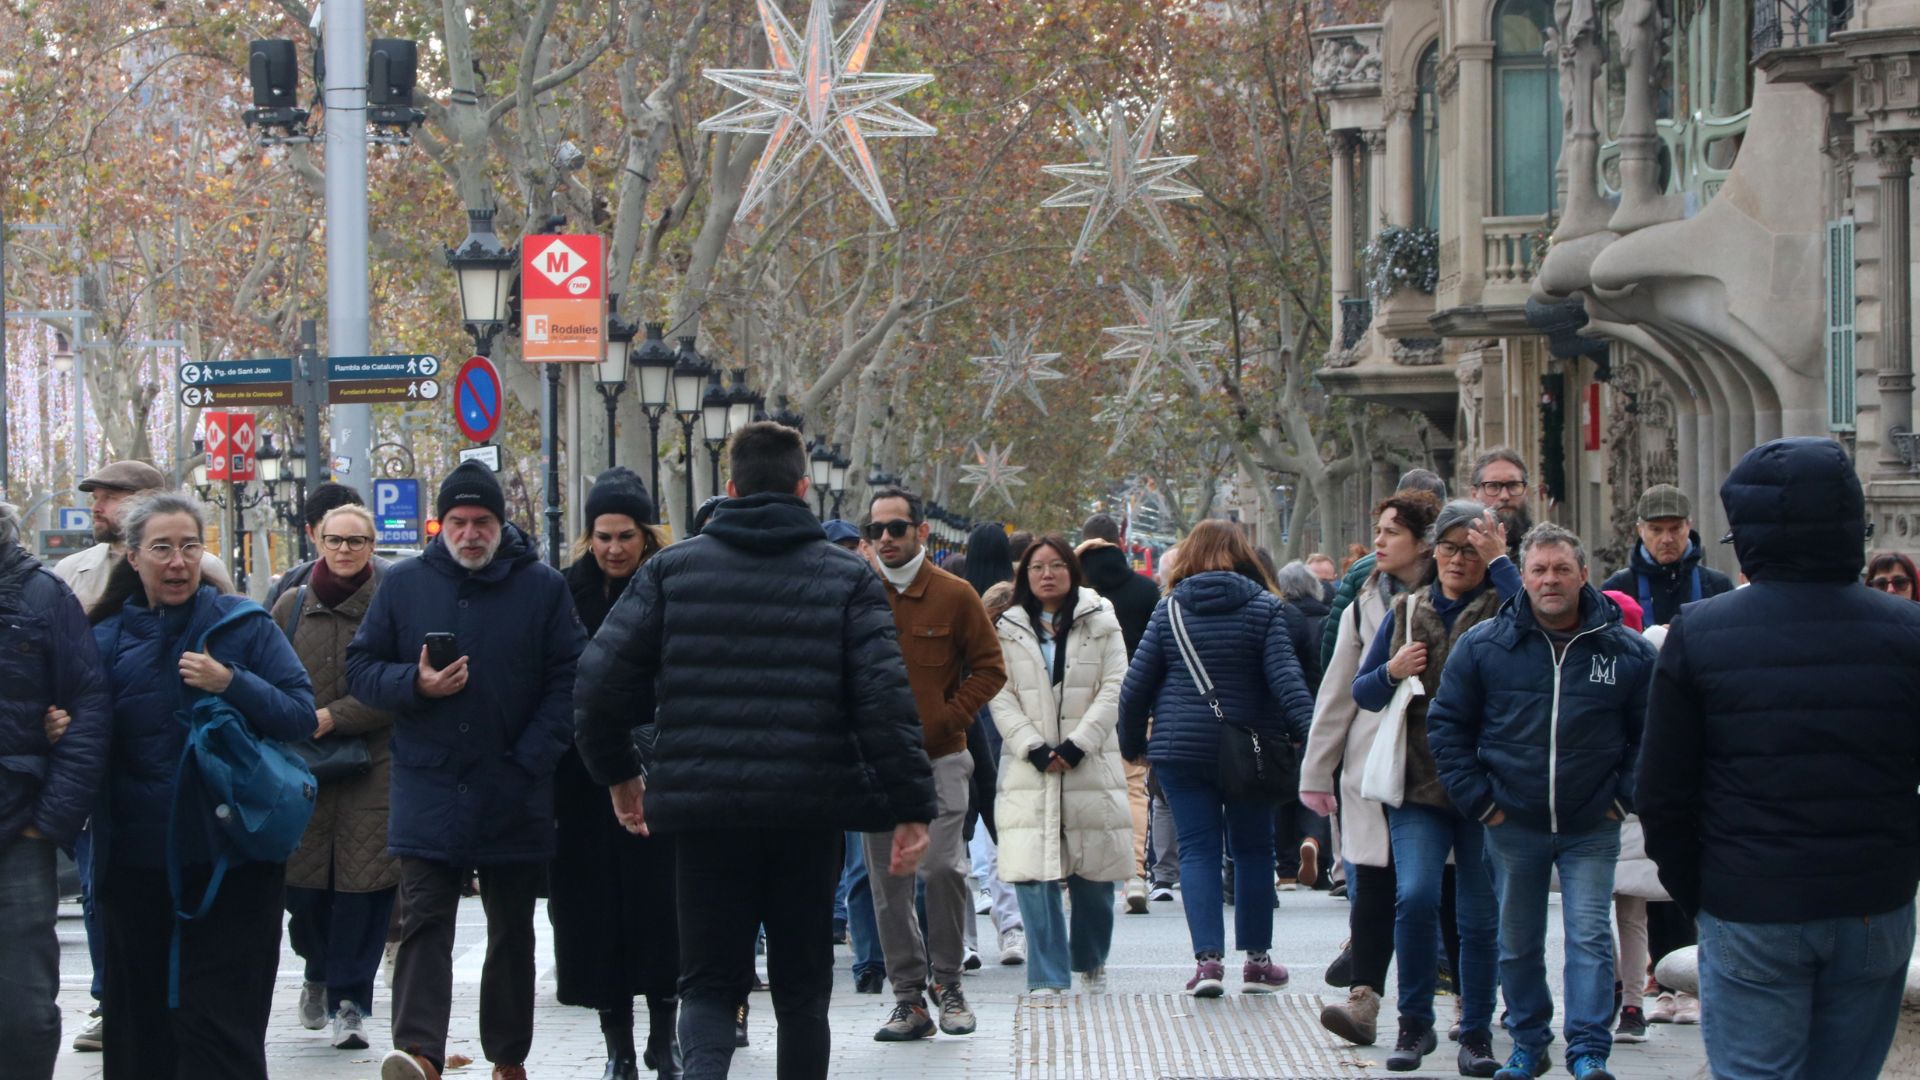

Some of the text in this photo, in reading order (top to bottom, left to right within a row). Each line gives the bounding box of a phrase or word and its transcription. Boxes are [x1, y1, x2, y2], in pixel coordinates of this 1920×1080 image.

[547, 252, 569, 273] M
[535, 319, 598, 335] R Rodalies
[215, 369, 226, 377] Pg.
[371, 363, 404, 371] Catalunya
[215, 391, 236, 399] Mercat
[210, 429, 218, 442] M
[240, 430, 250, 444] M
[378, 483, 399, 515] P
[66, 511, 90, 530] P
[1590, 653, 1617, 685] M
